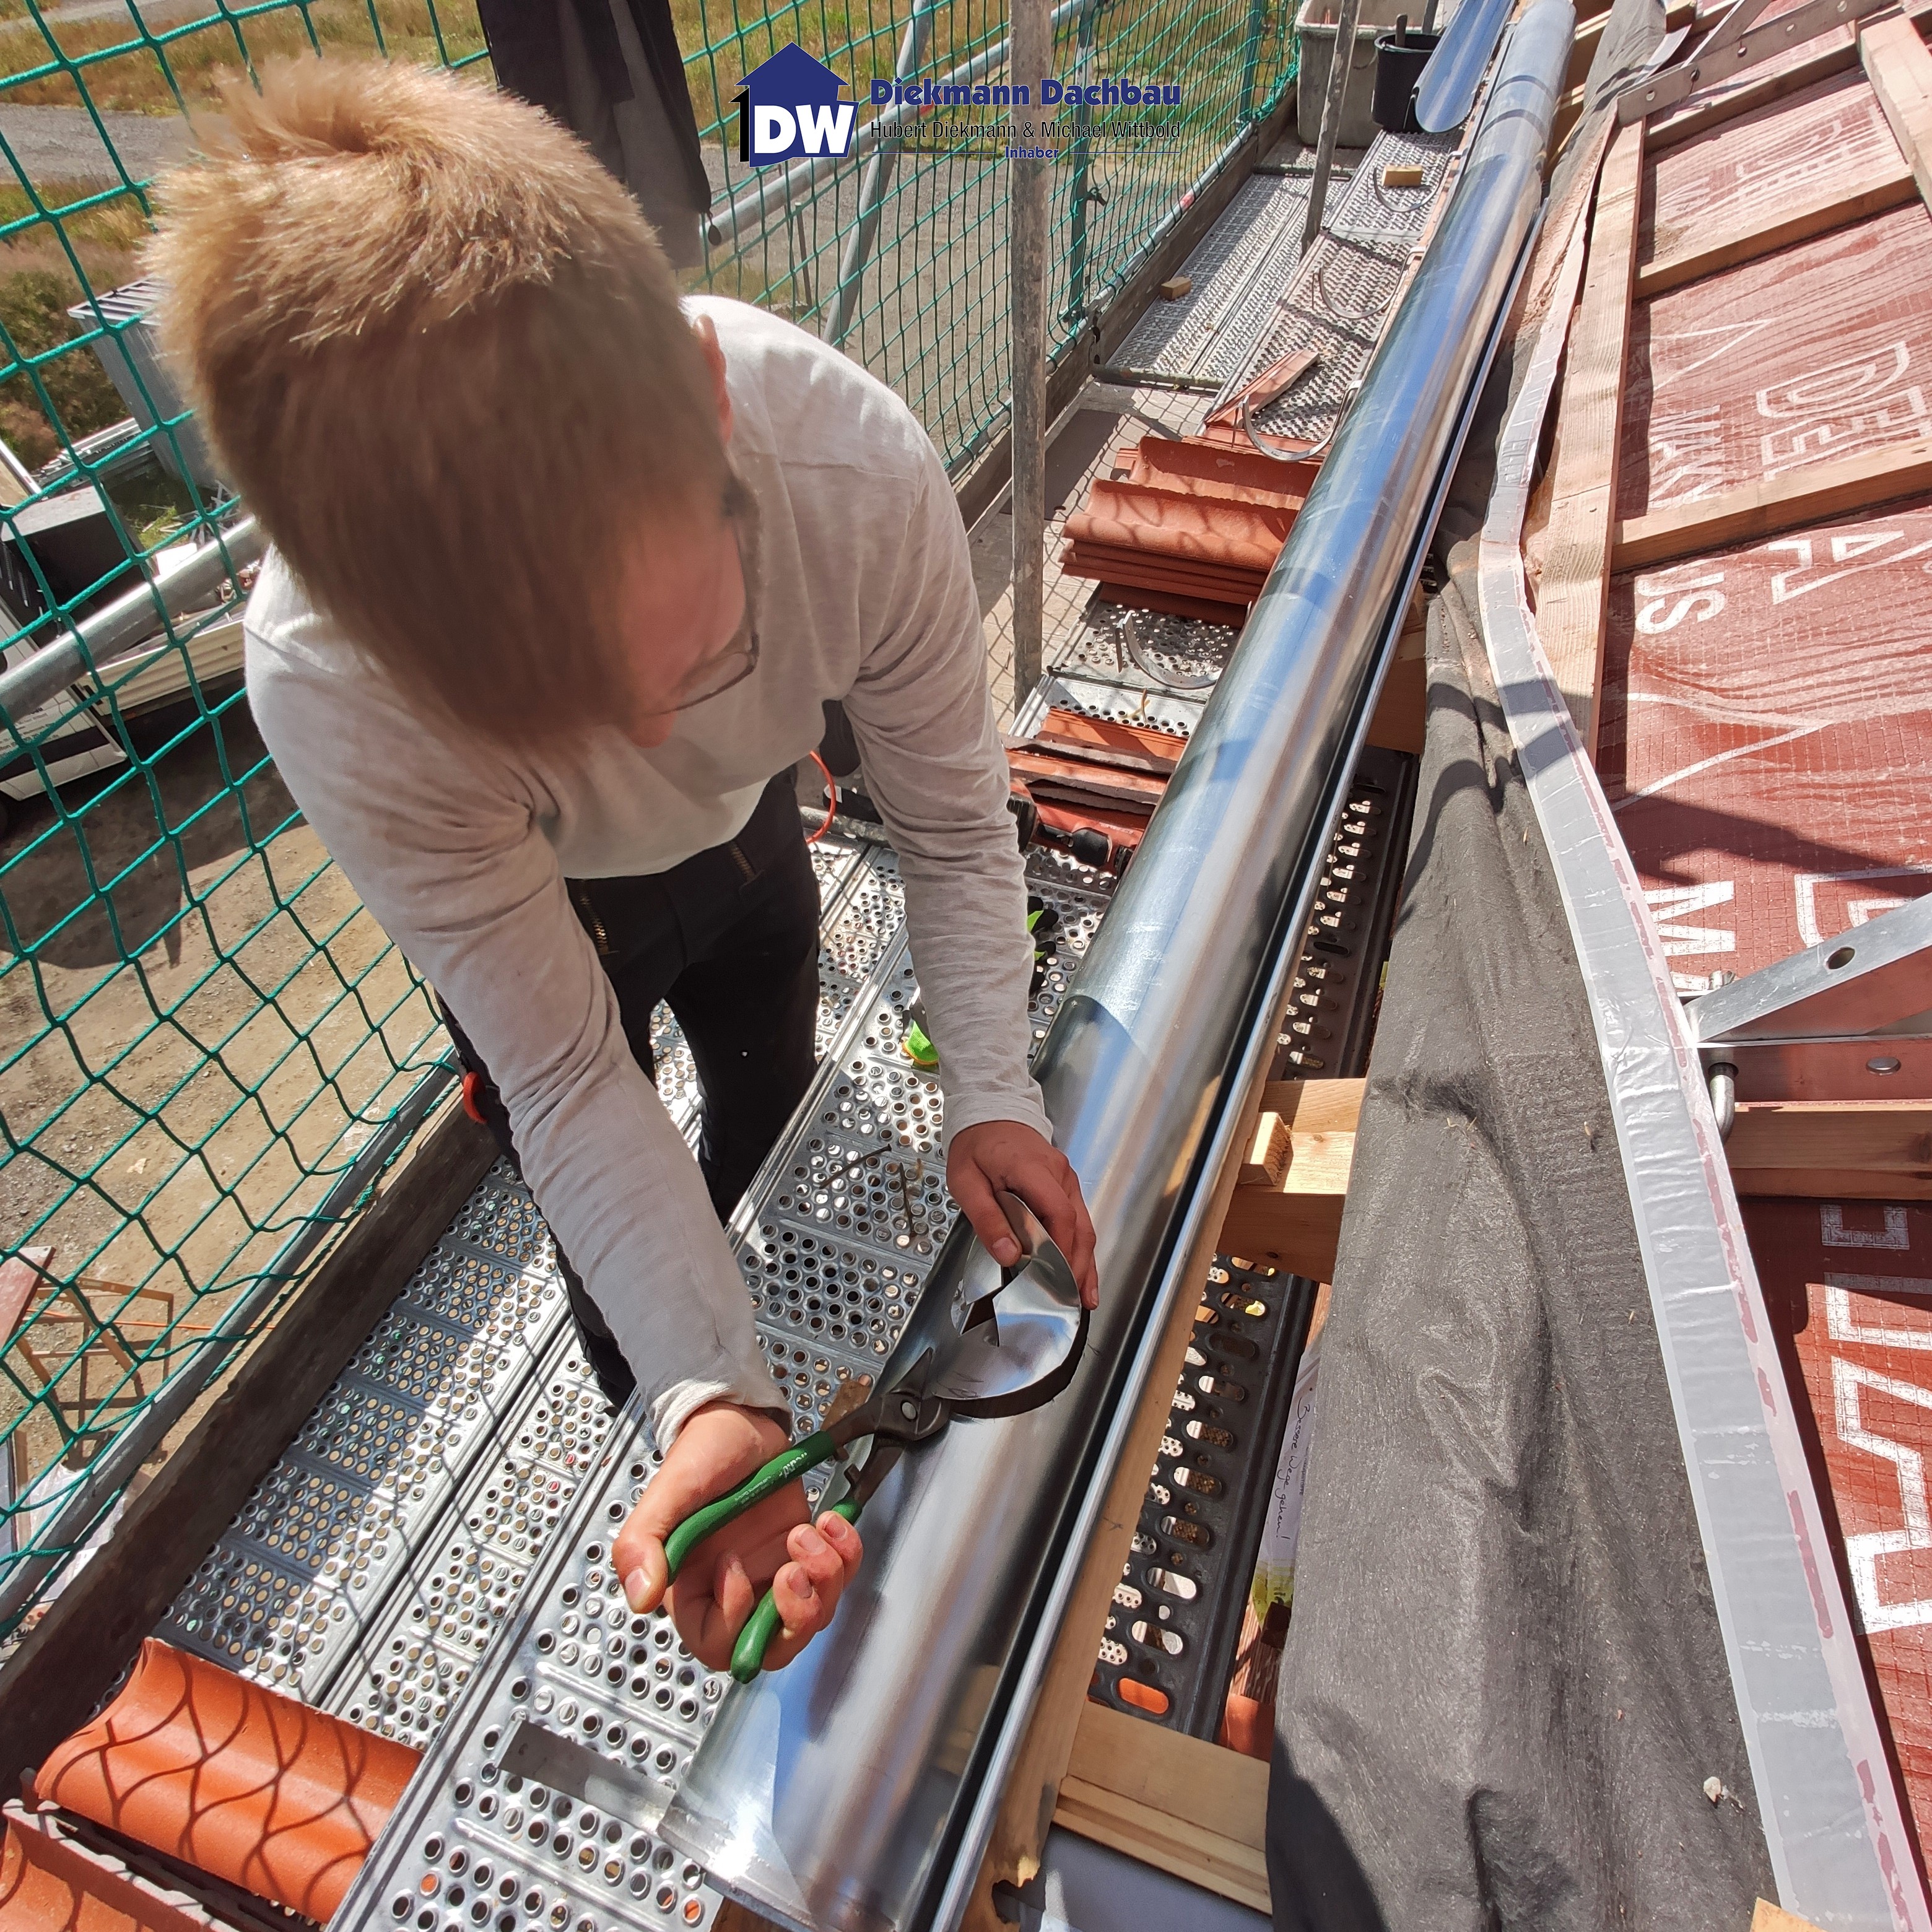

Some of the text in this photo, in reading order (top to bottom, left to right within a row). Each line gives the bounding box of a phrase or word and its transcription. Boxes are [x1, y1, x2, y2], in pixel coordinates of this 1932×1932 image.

[1291, 1397, 1310, 1450] Bessere
[1277, 1455, 1300, 1490] Wege
[1274, 1488, 1291, 1541] gehen!
